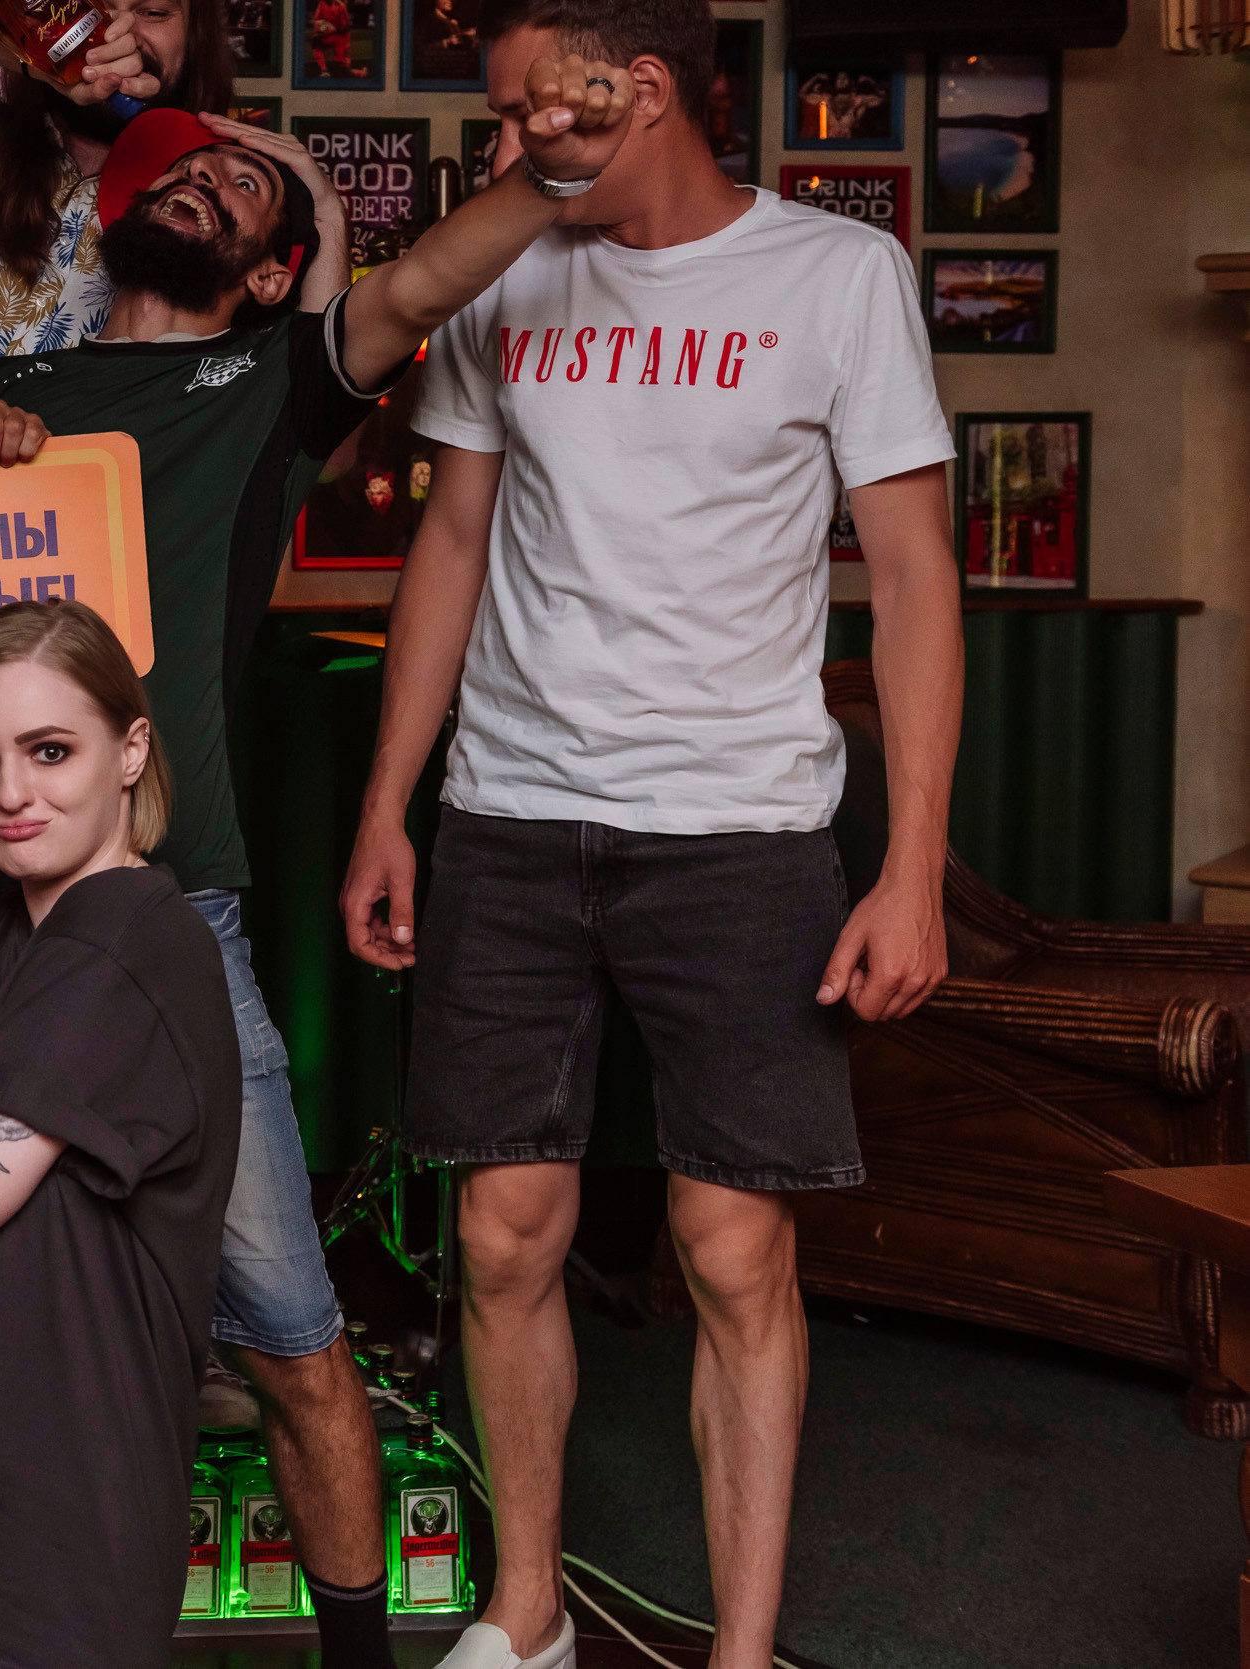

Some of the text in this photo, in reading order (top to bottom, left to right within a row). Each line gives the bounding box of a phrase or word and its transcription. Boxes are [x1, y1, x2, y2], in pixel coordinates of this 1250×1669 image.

[308, 133, 414, 159] DRINK
[796, 179, 894, 197] DRINK
[350, 195, 413, 222] BEER
[796, 198, 895, 219] OOD
[264, 1565, 275, 1574] 56
[425, 1558, 435, 1568] 56
